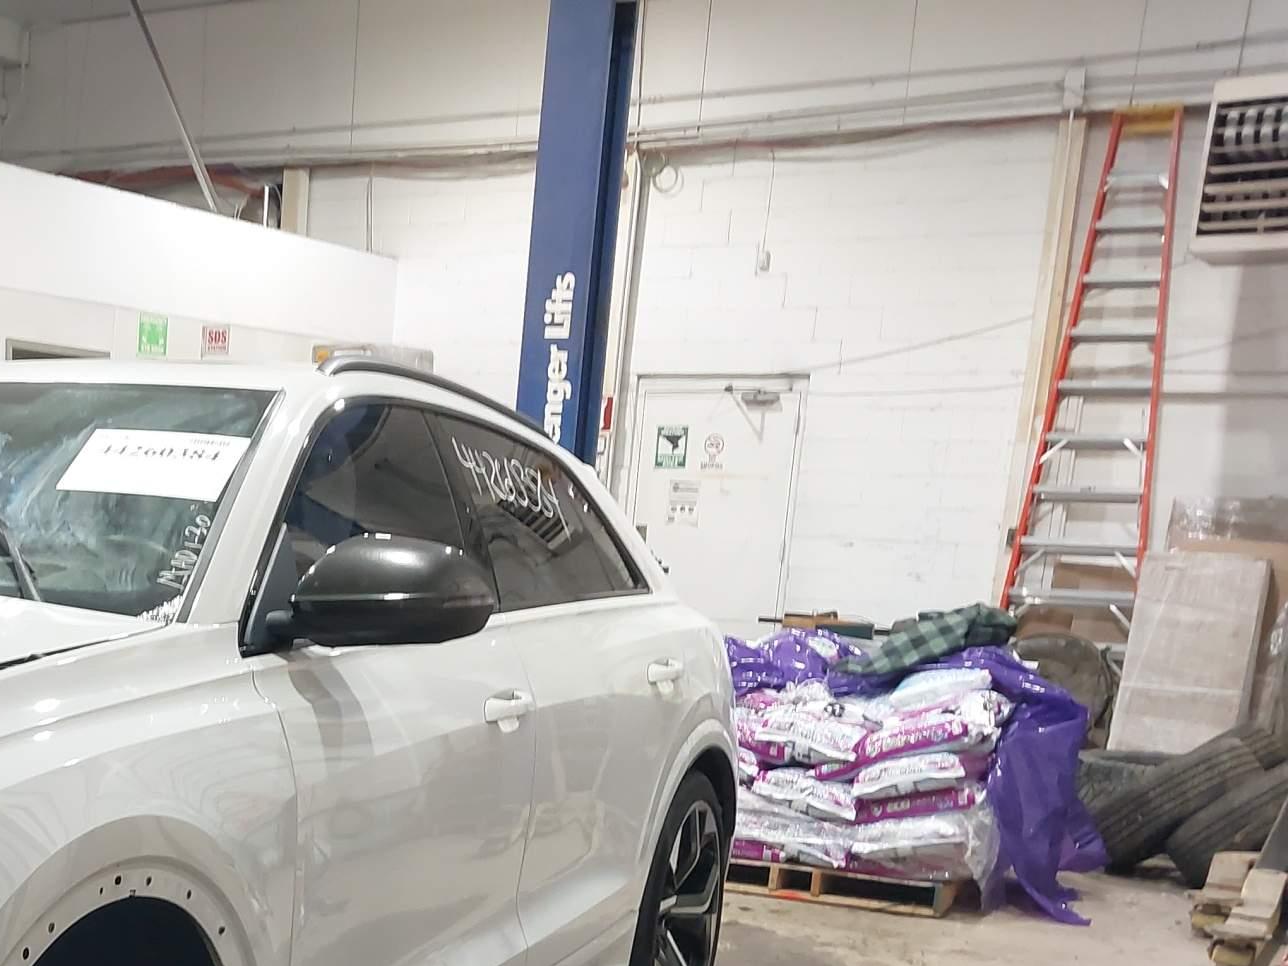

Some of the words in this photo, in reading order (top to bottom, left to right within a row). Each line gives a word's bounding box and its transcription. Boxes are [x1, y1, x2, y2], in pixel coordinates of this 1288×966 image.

[543, 271, 576, 340] Lifts
[207, 329, 227, 345] SOS
[99, 444, 221, 462] 44260384
[452, 436, 571, 542] 44260384
